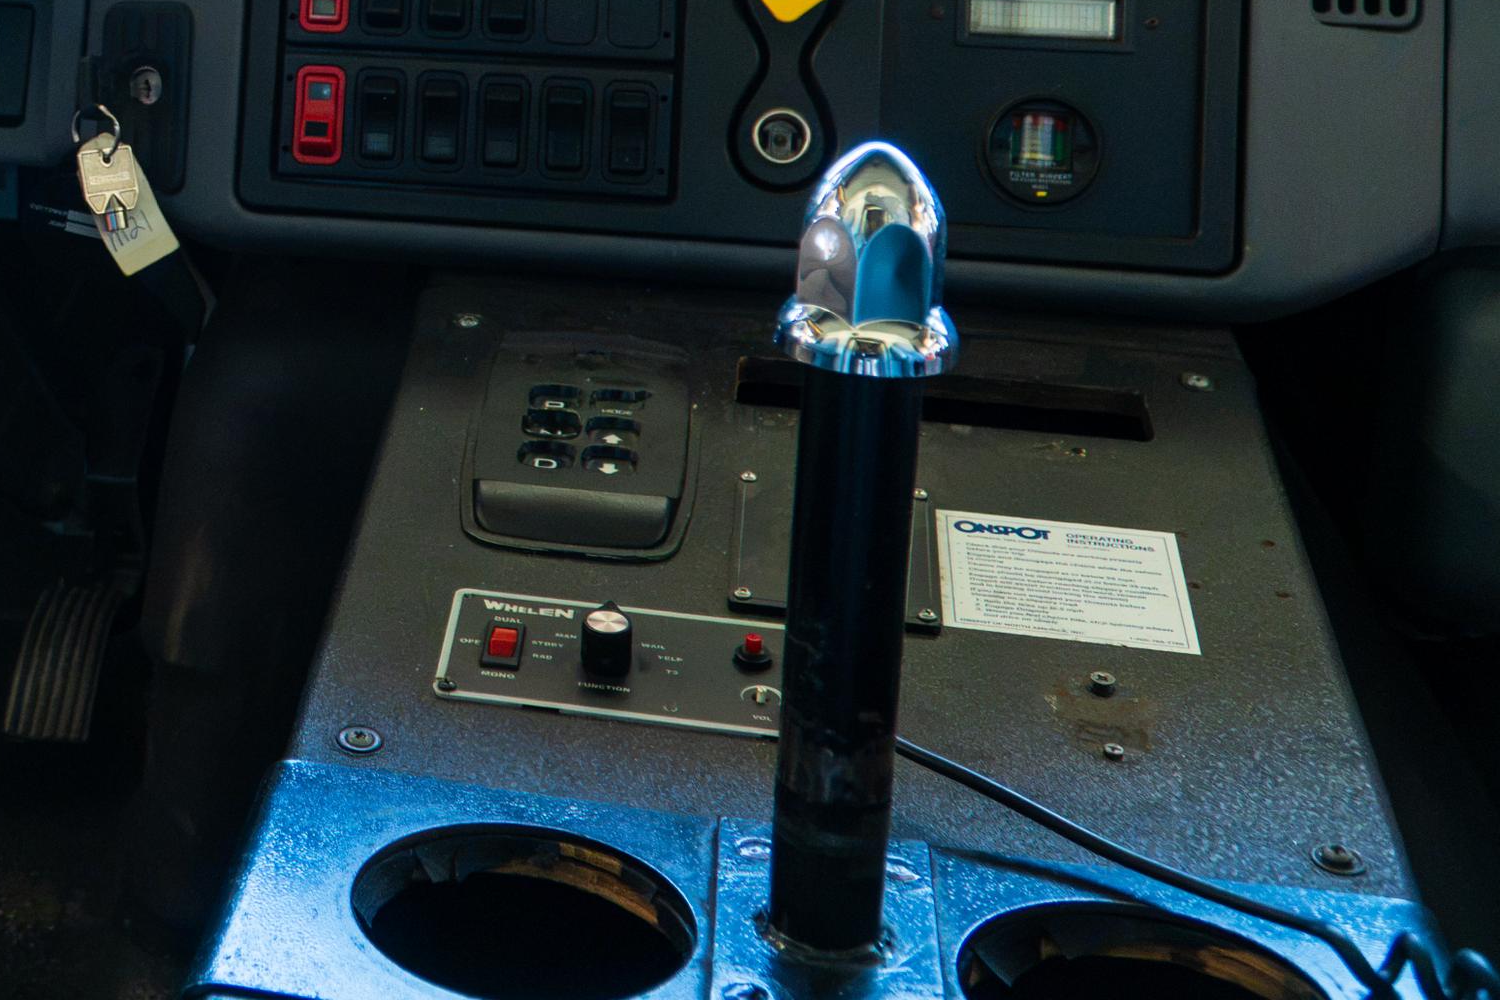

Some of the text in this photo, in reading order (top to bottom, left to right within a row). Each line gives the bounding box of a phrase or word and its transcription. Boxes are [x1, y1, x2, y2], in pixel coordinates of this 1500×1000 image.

[534, 457, 557, 469] D
[954, 520, 1051, 540] ONSPOT
[1066, 533, 1133, 544] OPERATING
[1067, 538, 1155, 552] INSTRUCTIONS
[483, 598, 576, 619] WHELEN
[494, 615, 523, 625] DUAL
[555, 632, 578, 640] MAN
[640, 641, 667, 651] WAIL
[657, 654, 684, 663] YELP
[480, 670, 516, 681] MONO
[577, 680, 631, 694] FUNCTION
[752, 713, 773, 722] VOL
